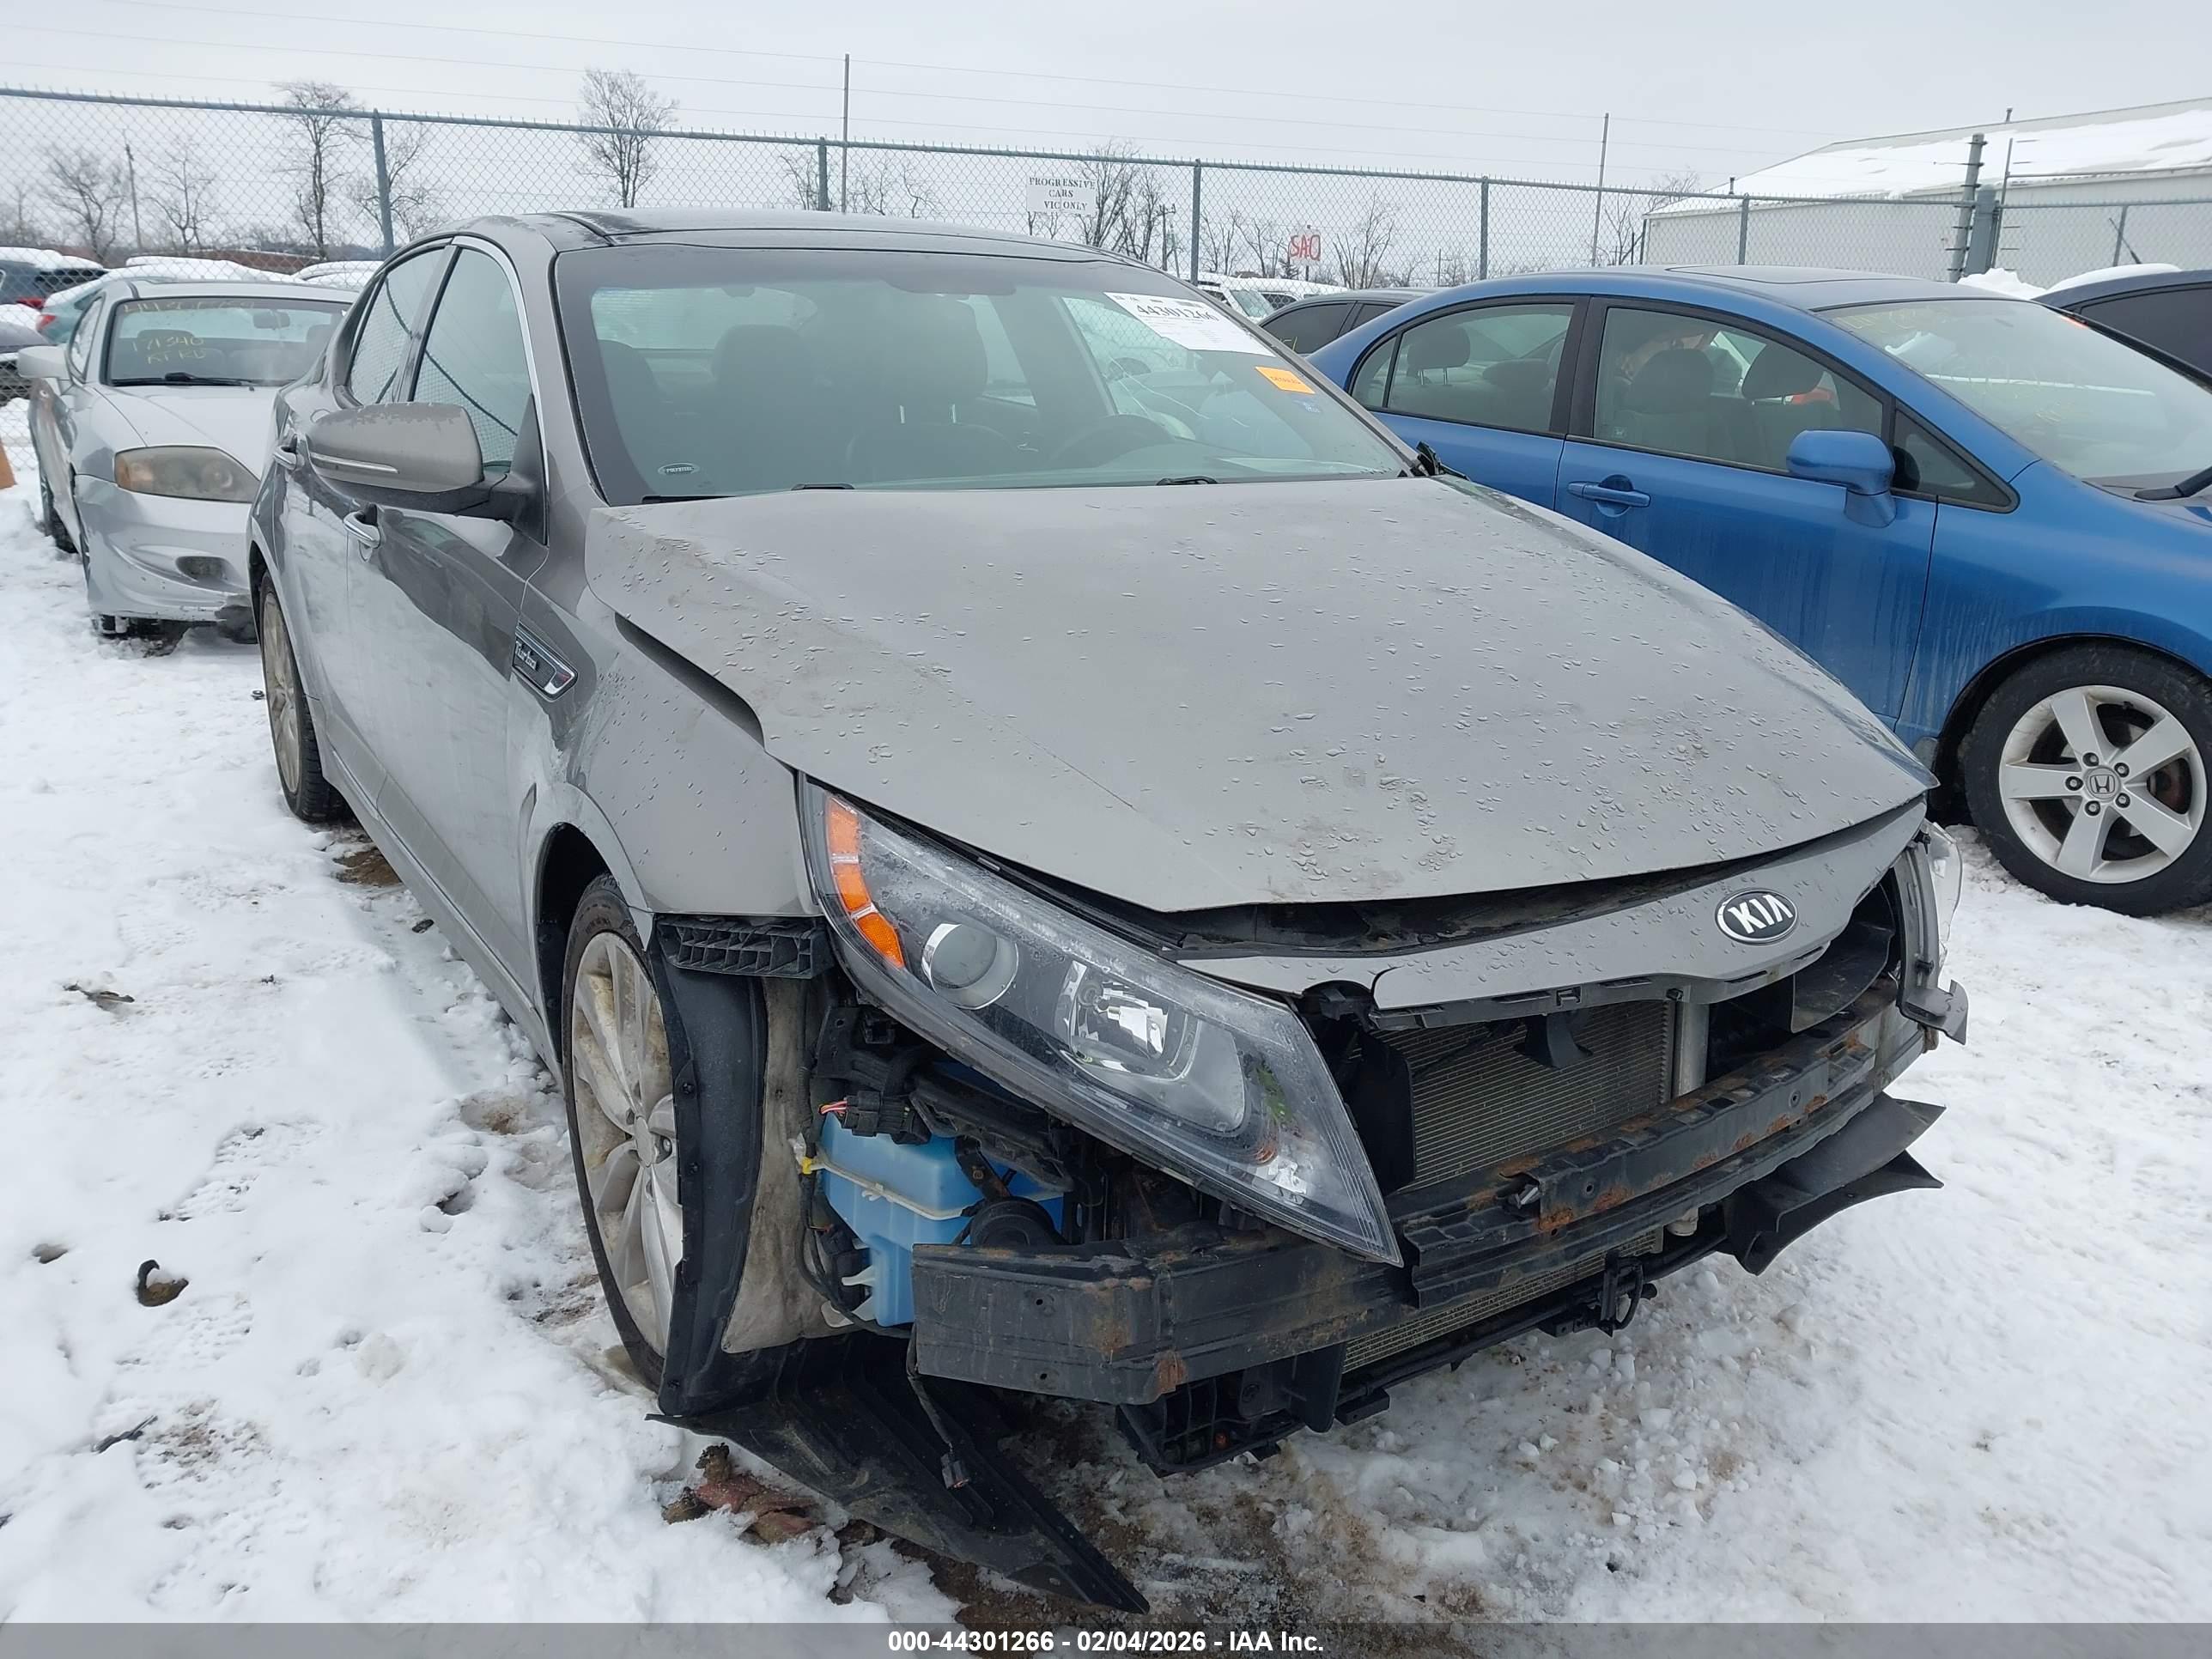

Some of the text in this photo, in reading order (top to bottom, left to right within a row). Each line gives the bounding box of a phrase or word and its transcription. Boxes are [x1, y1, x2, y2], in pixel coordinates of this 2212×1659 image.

[1029, 177, 1096, 190] PROGRESSIVE
[1048, 189, 1073, 198] CARS
[1063, 201, 1087, 210] ONLY
[1136, 304, 1220, 322] 44301266
[515, 641, 538, 671] Turbo
[1727, 894, 1794, 934] KIA
